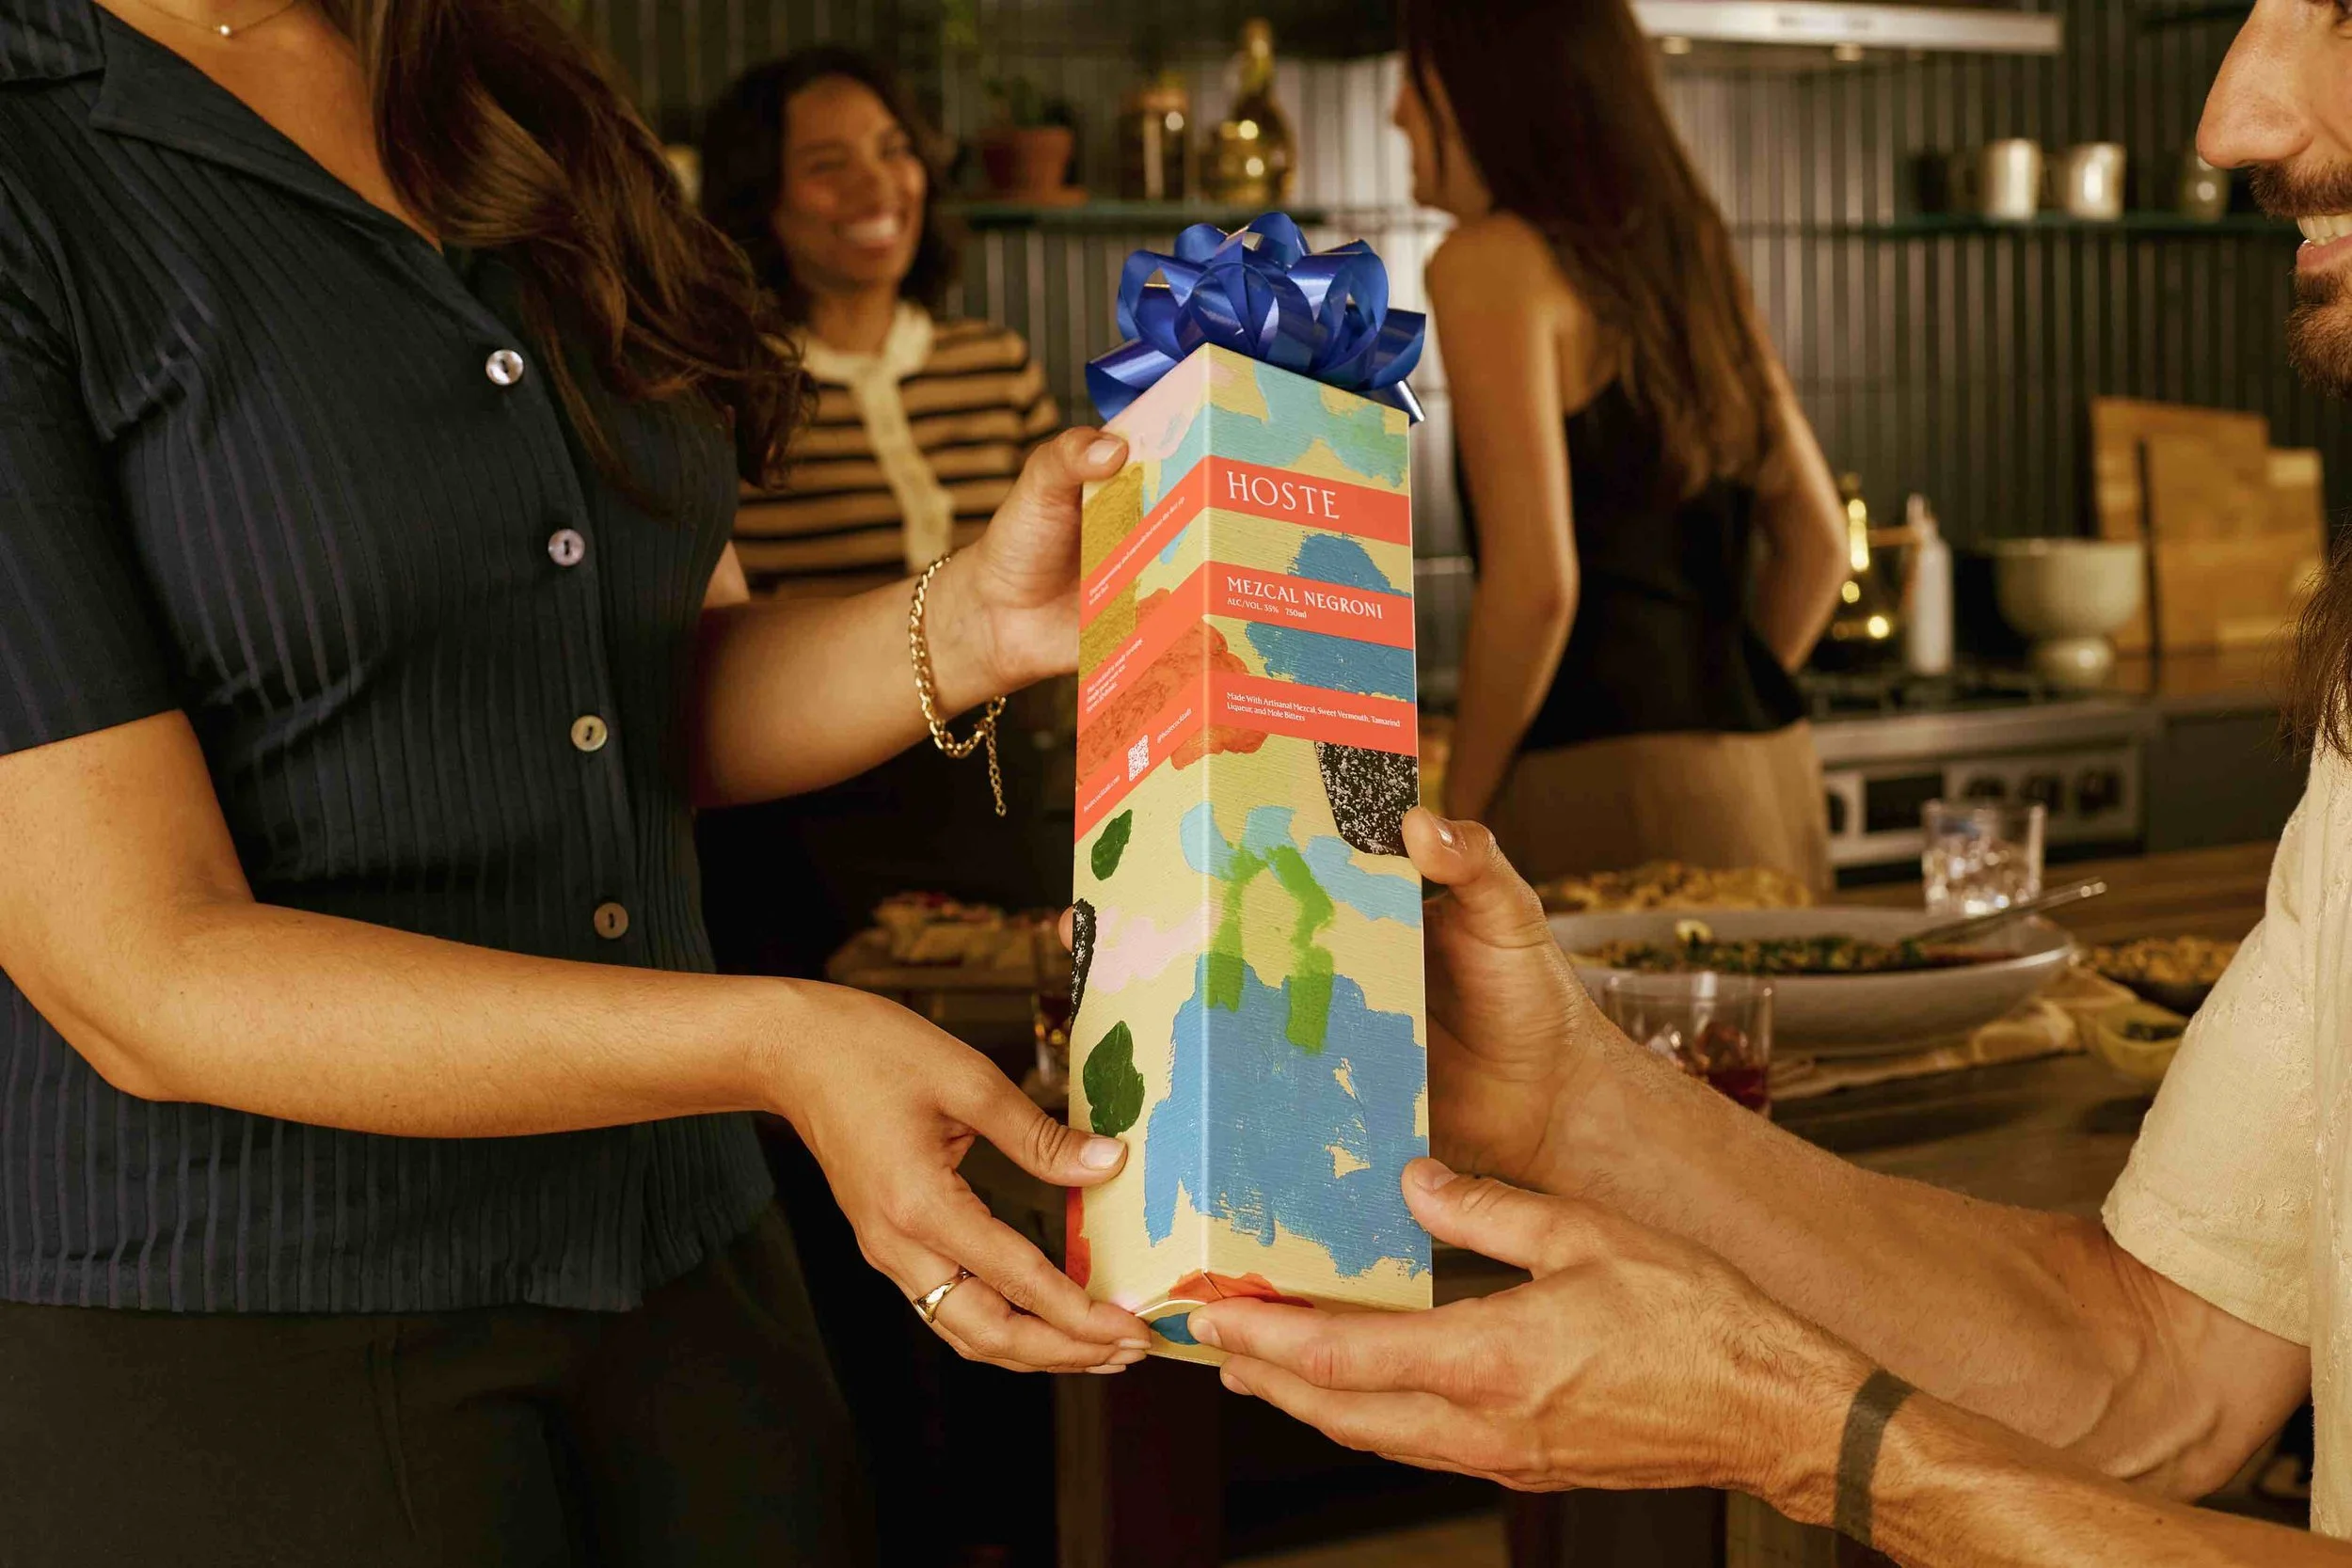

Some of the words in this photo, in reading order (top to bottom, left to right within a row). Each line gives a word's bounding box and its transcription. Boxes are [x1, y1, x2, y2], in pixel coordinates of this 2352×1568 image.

[1227, 470, 1340, 519] HOSTE
[1227, 576, 1299, 604] MEZCAL
[1304, 591, 1383, 619] NEGRONI
[1263, 604, 1279, 614] 35%
[1285, 608, 1308, 619] 750ml
[1227, 691, 1246, 702] Made
[1246, 694, 1263, 705] With
[1263, 698, 1293, 710] Artisanal
[1317, 706, 1337, 717] Sweet
[1371, 716, 1401, 728] Tamarind
[1227, 702, 1253, 714] Liqueur,
[1254, 706, 1267, 716] and
[1267, 709, 1284, 719] Mole
[1284, 712, 1306, 721] Bitters
